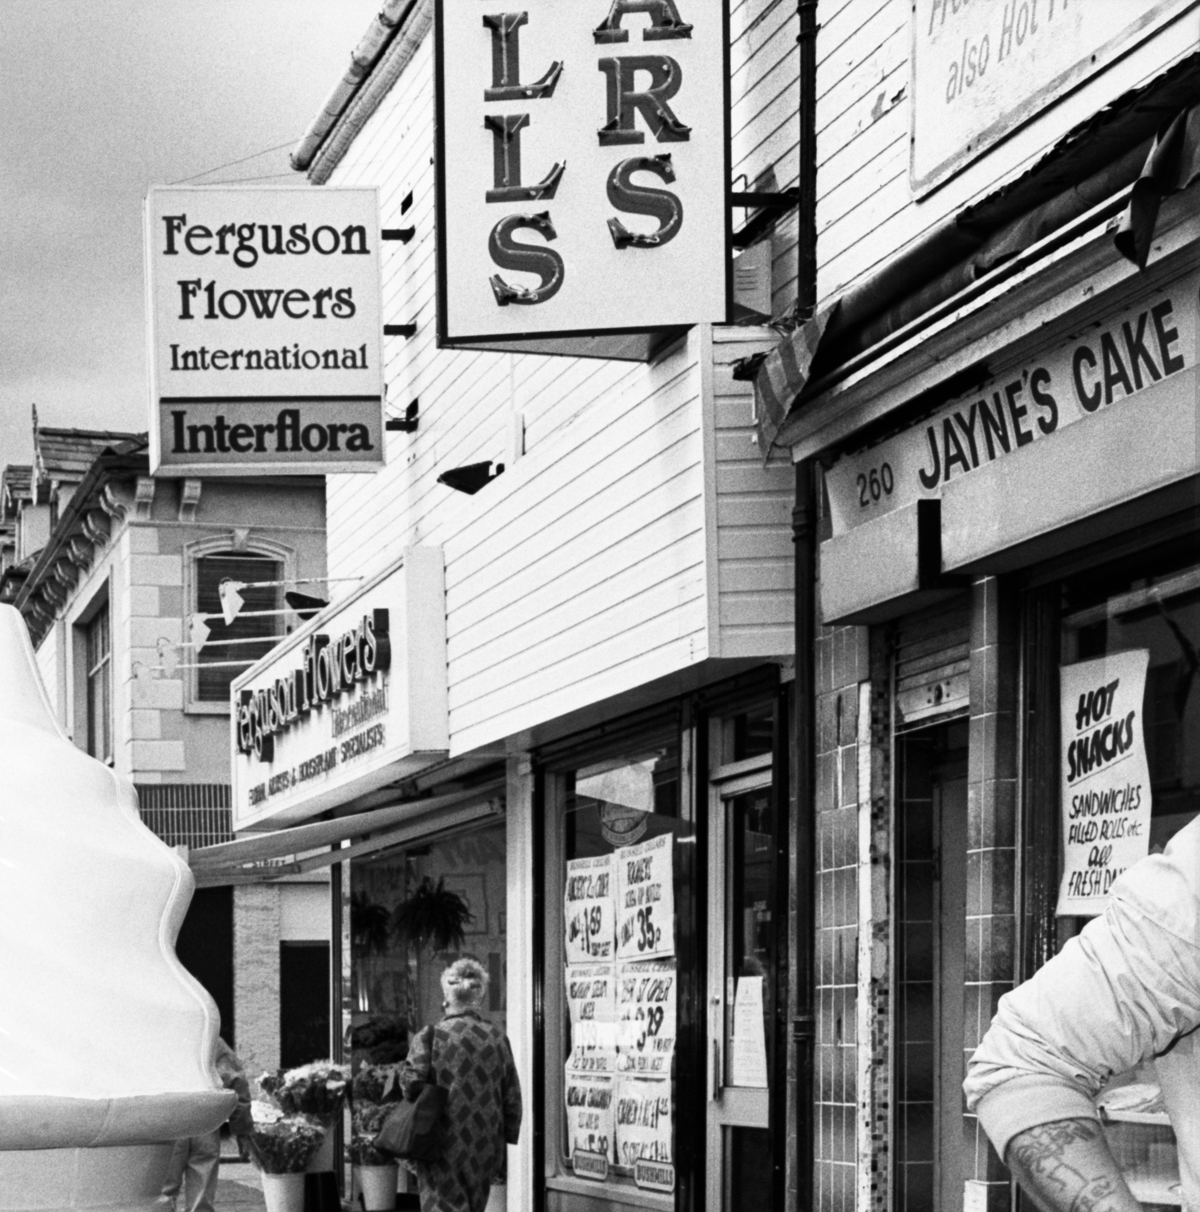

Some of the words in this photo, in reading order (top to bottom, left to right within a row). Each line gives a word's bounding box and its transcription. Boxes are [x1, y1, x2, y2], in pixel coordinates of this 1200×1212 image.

[945, 34, 990, 104] also
[997, 0, 1039, 63] Hot
[162, 213, 371, 268] Ferguson
[177, 278, 357, 320] Flowers
[169, 342, 369, 371] International
[918, 366, 1060, 491] JAYNE'S
[1071, 299, 1186, 413] CAKE
[171, 408, 375, 454] Interflora
[855, 461, 895, 508] 260
[302, 609, 390, 711] Flowers
[1075, 678, 1120, 731] HOT
[1067, 710, 1136, 783] SNACKS
[1068, 783, 1142, 820] SANDWICHES
[1068, 821, 1099, 845] FILLED
[1088, 844, 1113, 868] all
[1067, 869, 1102, 897] FRESH
[636, 1164, 674, 1186] BUSHMILLS
